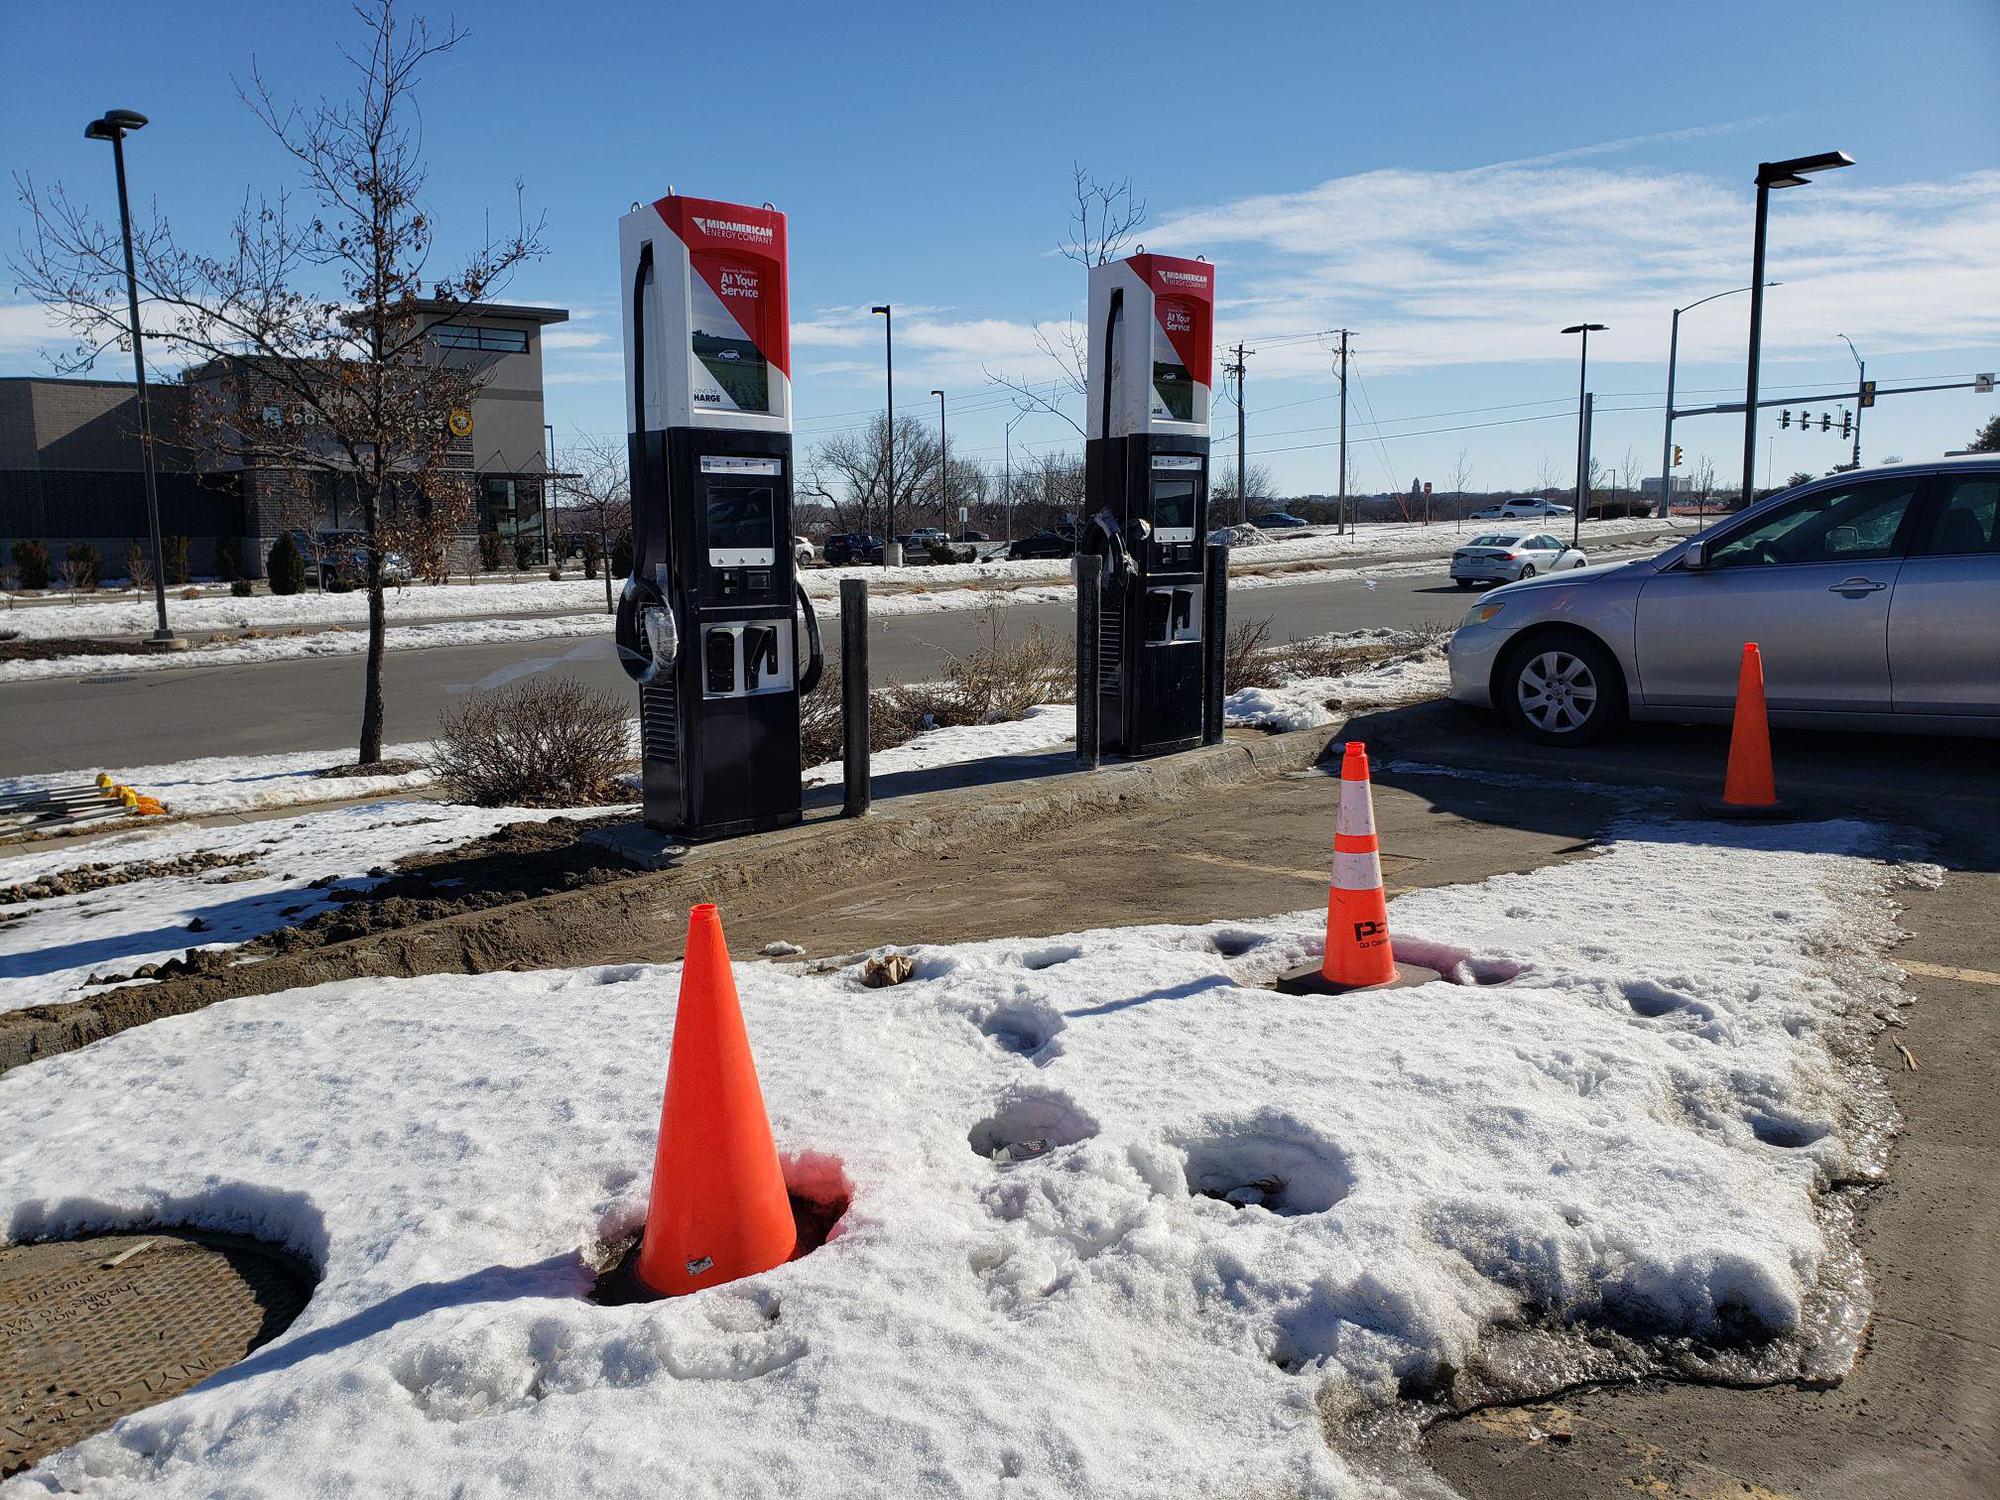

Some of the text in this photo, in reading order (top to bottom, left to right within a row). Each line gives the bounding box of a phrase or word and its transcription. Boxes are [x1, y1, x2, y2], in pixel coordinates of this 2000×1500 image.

[707, 219, 773, 237] MIDAMERICAN
[707, 228, 773, 245] ENERGY COMPANY
[721, 273, 758, 287] At Your
[1167, 271, 1207, 283] MIDAMERICAN
[721, 284, 758, 298] Service
[1167, 313, 1190, 323] At Your
[1167, 321, 1190, 332] Service
[693, 394, 720, 402] HARGE
[87, 1299, 112, 1312] DO
